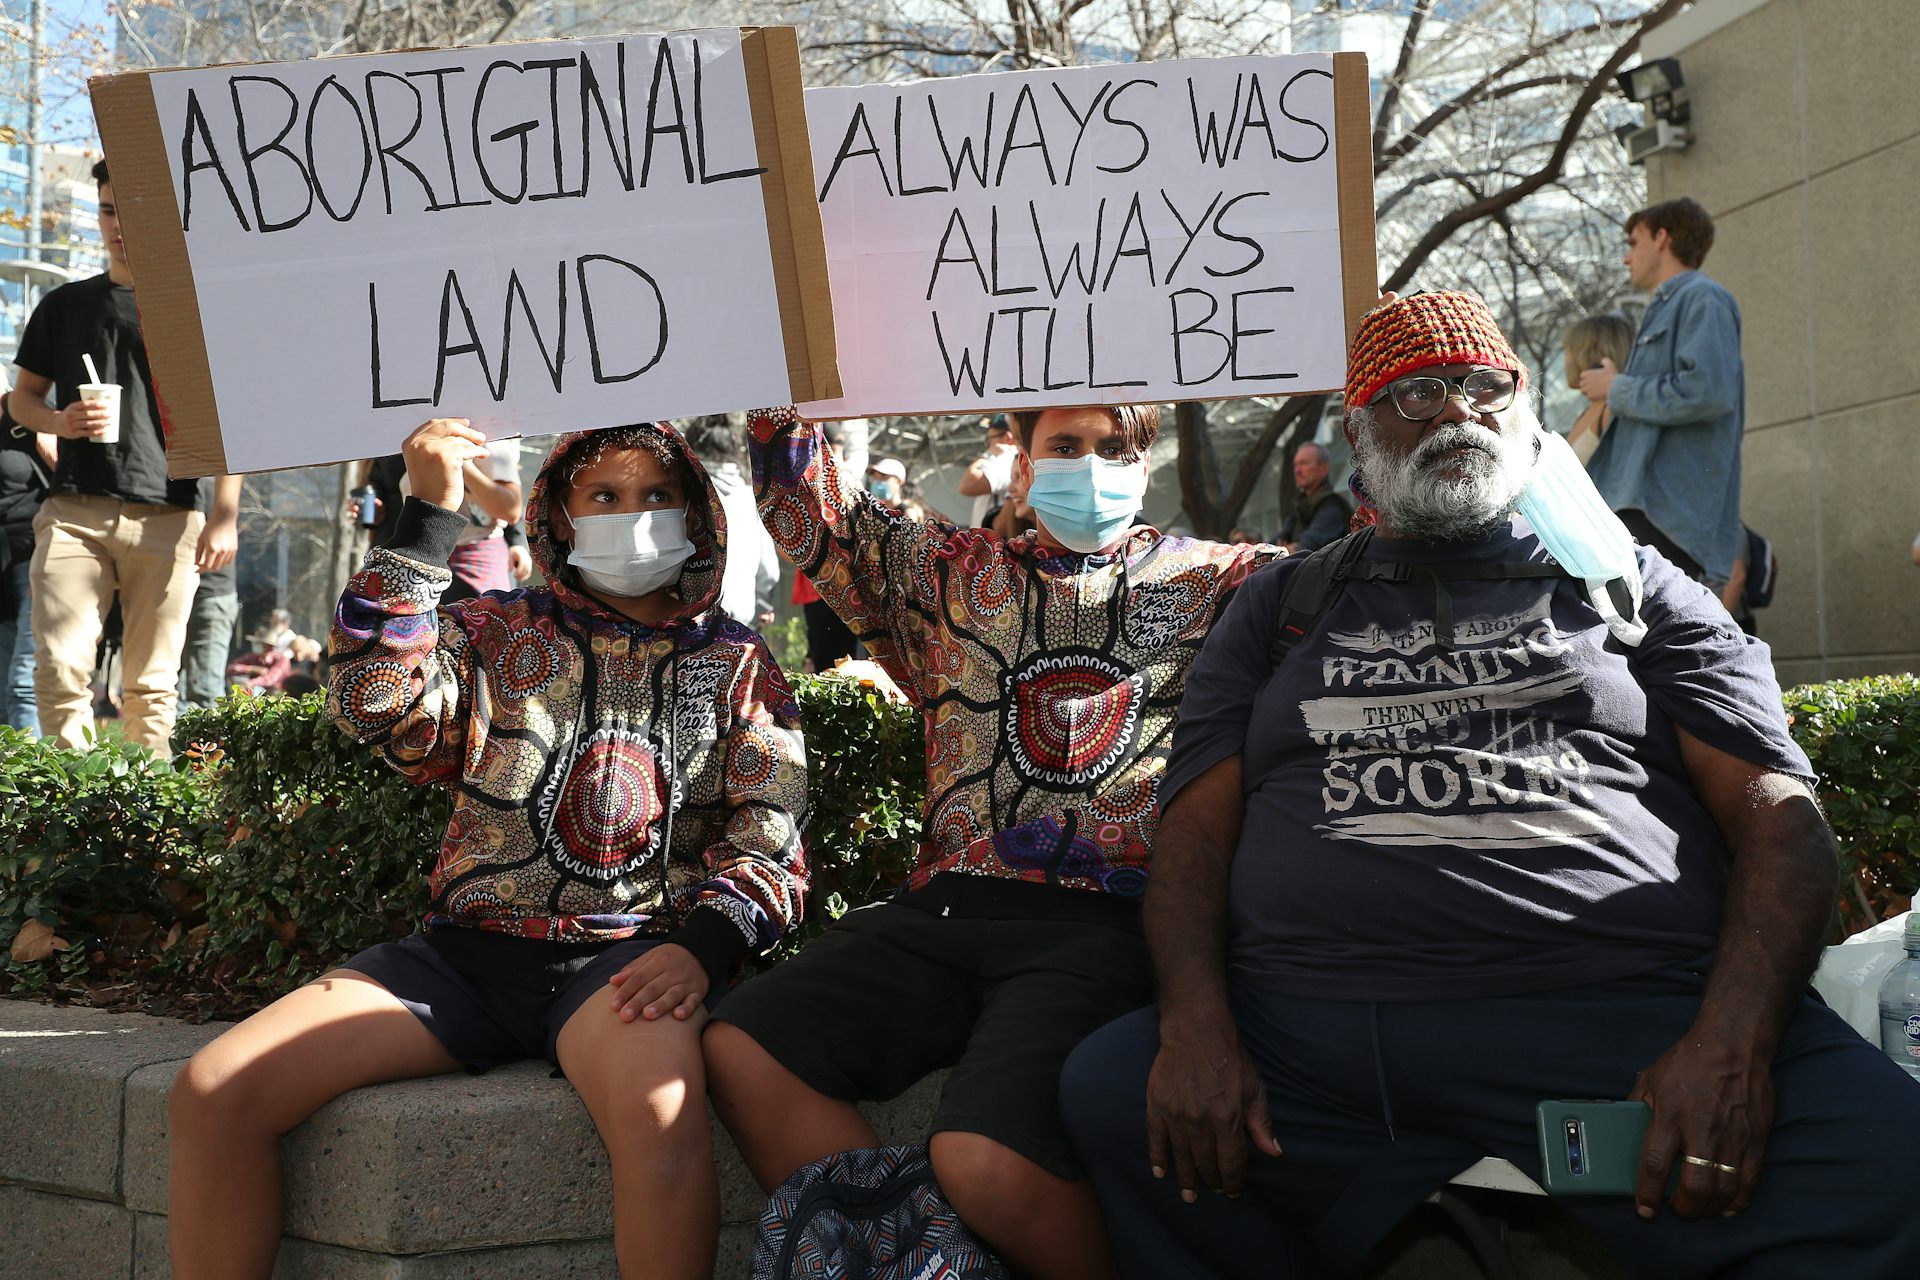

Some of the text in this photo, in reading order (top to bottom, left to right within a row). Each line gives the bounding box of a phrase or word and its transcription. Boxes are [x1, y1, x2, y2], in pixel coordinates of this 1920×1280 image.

[181, 38, 768, 234] ABORIGINAL
[819, 69, 1333, 203] ALWAYS WAS
[926, 191, 1271, 300] ALWAYS
[368, 255, 668, 409] LAND
[932, 287, 1299, 398] WILL BE
[1418, 625, 1459, 640] NT
[1363, 694, 1487, 726] THEN WHY
[1322, 748, 1595, 813] SCORE?
[1906, 1025, 1920, 1035] RID
[911, 1249, 944, 1280] eet-Bix
